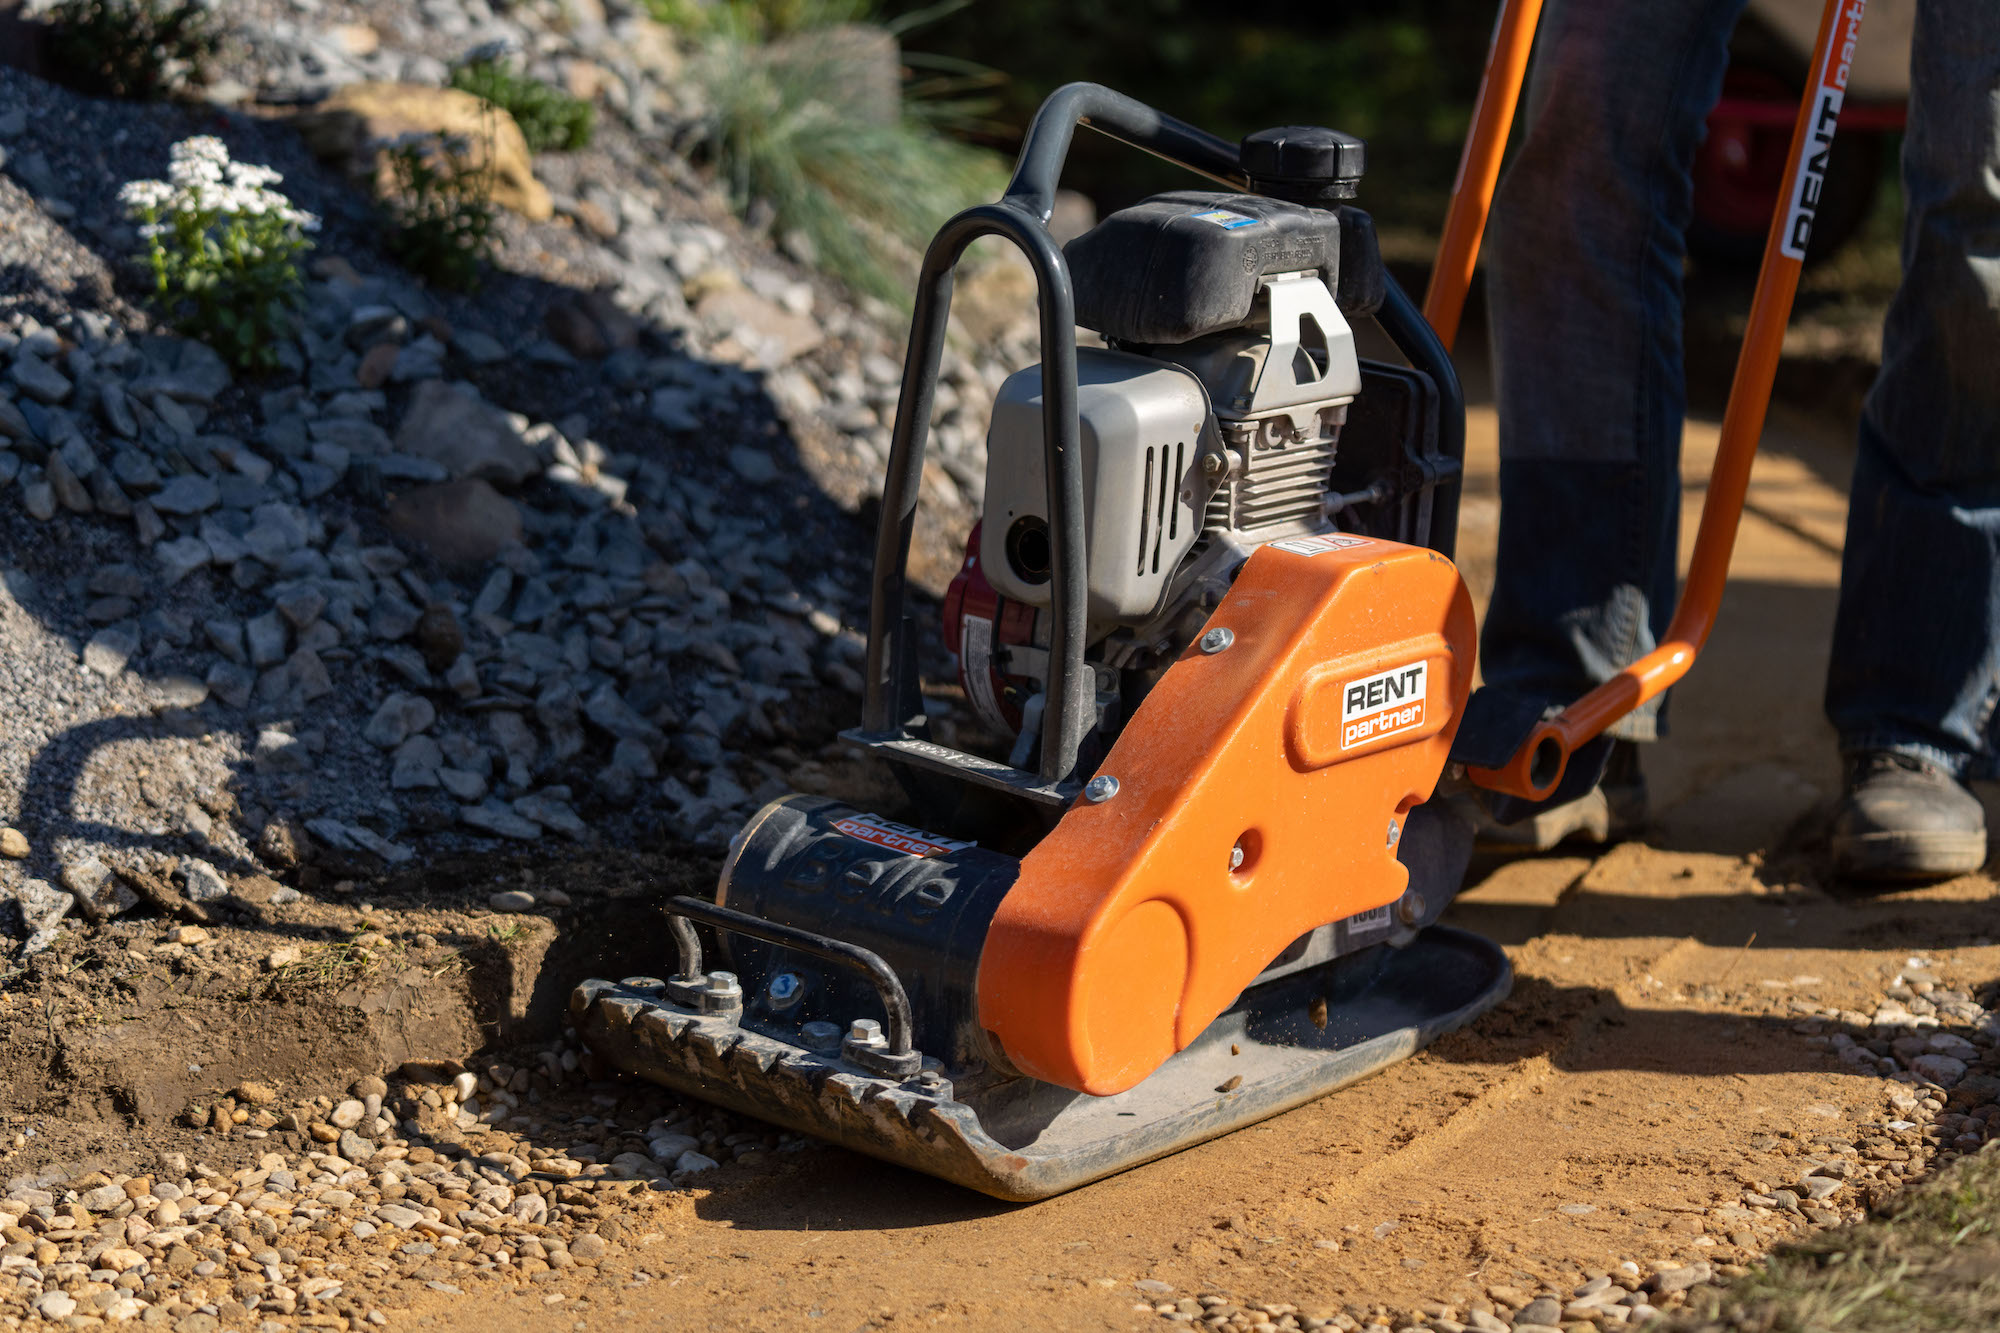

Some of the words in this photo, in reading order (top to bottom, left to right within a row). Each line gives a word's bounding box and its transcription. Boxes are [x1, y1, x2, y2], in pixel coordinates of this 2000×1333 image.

[1834, 0, 1867, 87] part
[1347, 667, 1423, 715] RENT
[1345, 704, 1421, 746] partner
[840, 821, 932, 855] partne
